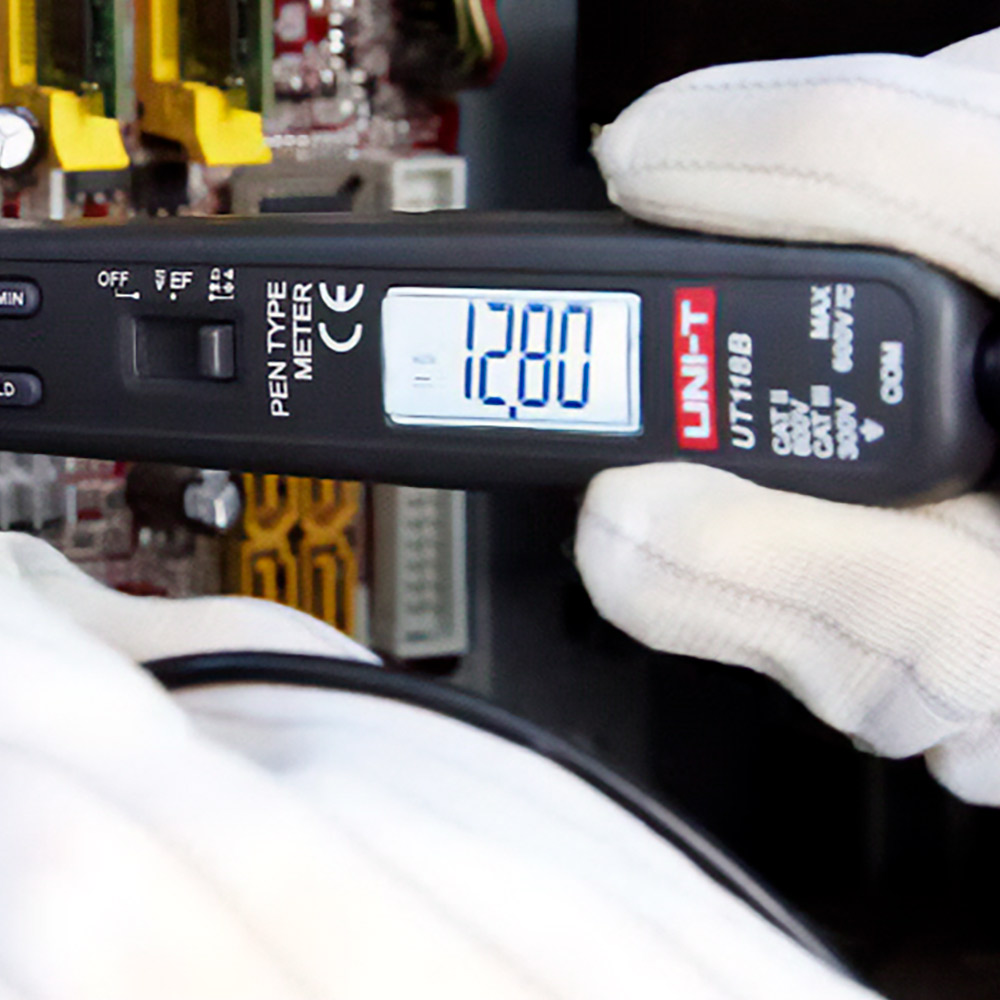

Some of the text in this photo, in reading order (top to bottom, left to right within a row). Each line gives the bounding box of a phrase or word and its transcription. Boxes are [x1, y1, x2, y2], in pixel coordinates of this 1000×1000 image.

[97, 270, 130, 288] OFF
[169, 271, 194, 289] EF
[318, 281, 365, 353] CE
[266, 281, 290, 417] PEN TYPE
[292, 282, 313, 381] METER
[464, 301, 592, 420] 12.80
[680, 299, 711, 439] UNI-T
[880, 340, 905, 405] COM
[727, 331, 757, 450] UT118B
